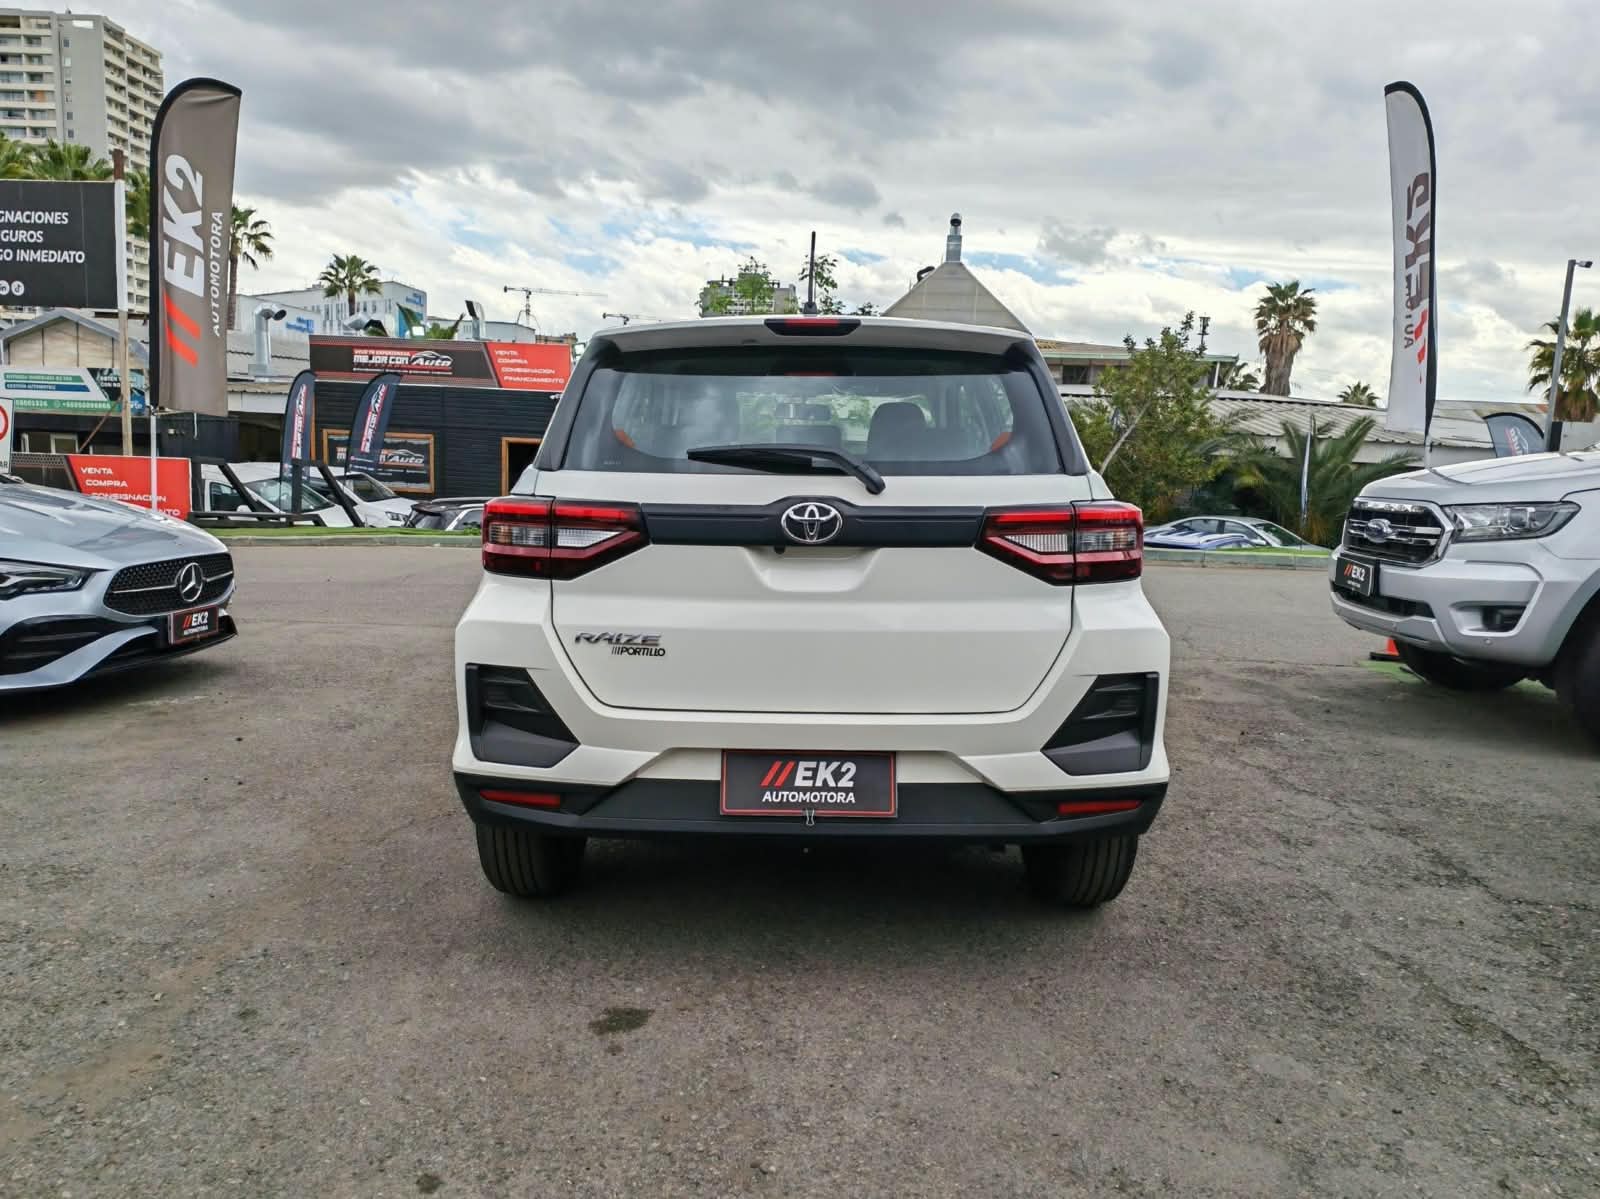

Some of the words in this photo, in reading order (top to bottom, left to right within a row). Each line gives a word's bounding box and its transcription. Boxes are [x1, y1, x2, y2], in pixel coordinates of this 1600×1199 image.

[163, 153, 205, 297] EK2
[0, 230, 44, 243] GUROS
[16, 249, 86, 263] INMEDIATO
[209, 212, 224, 337] AUTOMOTORA
[412, 358, 452, 367] Auto
[81, 467, 113, 475] VENTA
[85, 479, 128, 487] COMPRA
[191, 611, 209, 626] EK2
[575, 632, 661, 647] RAIZE
[793, 760, 857, 788] EK2
[761, 790, 856, 804] AUTOMOTORA
